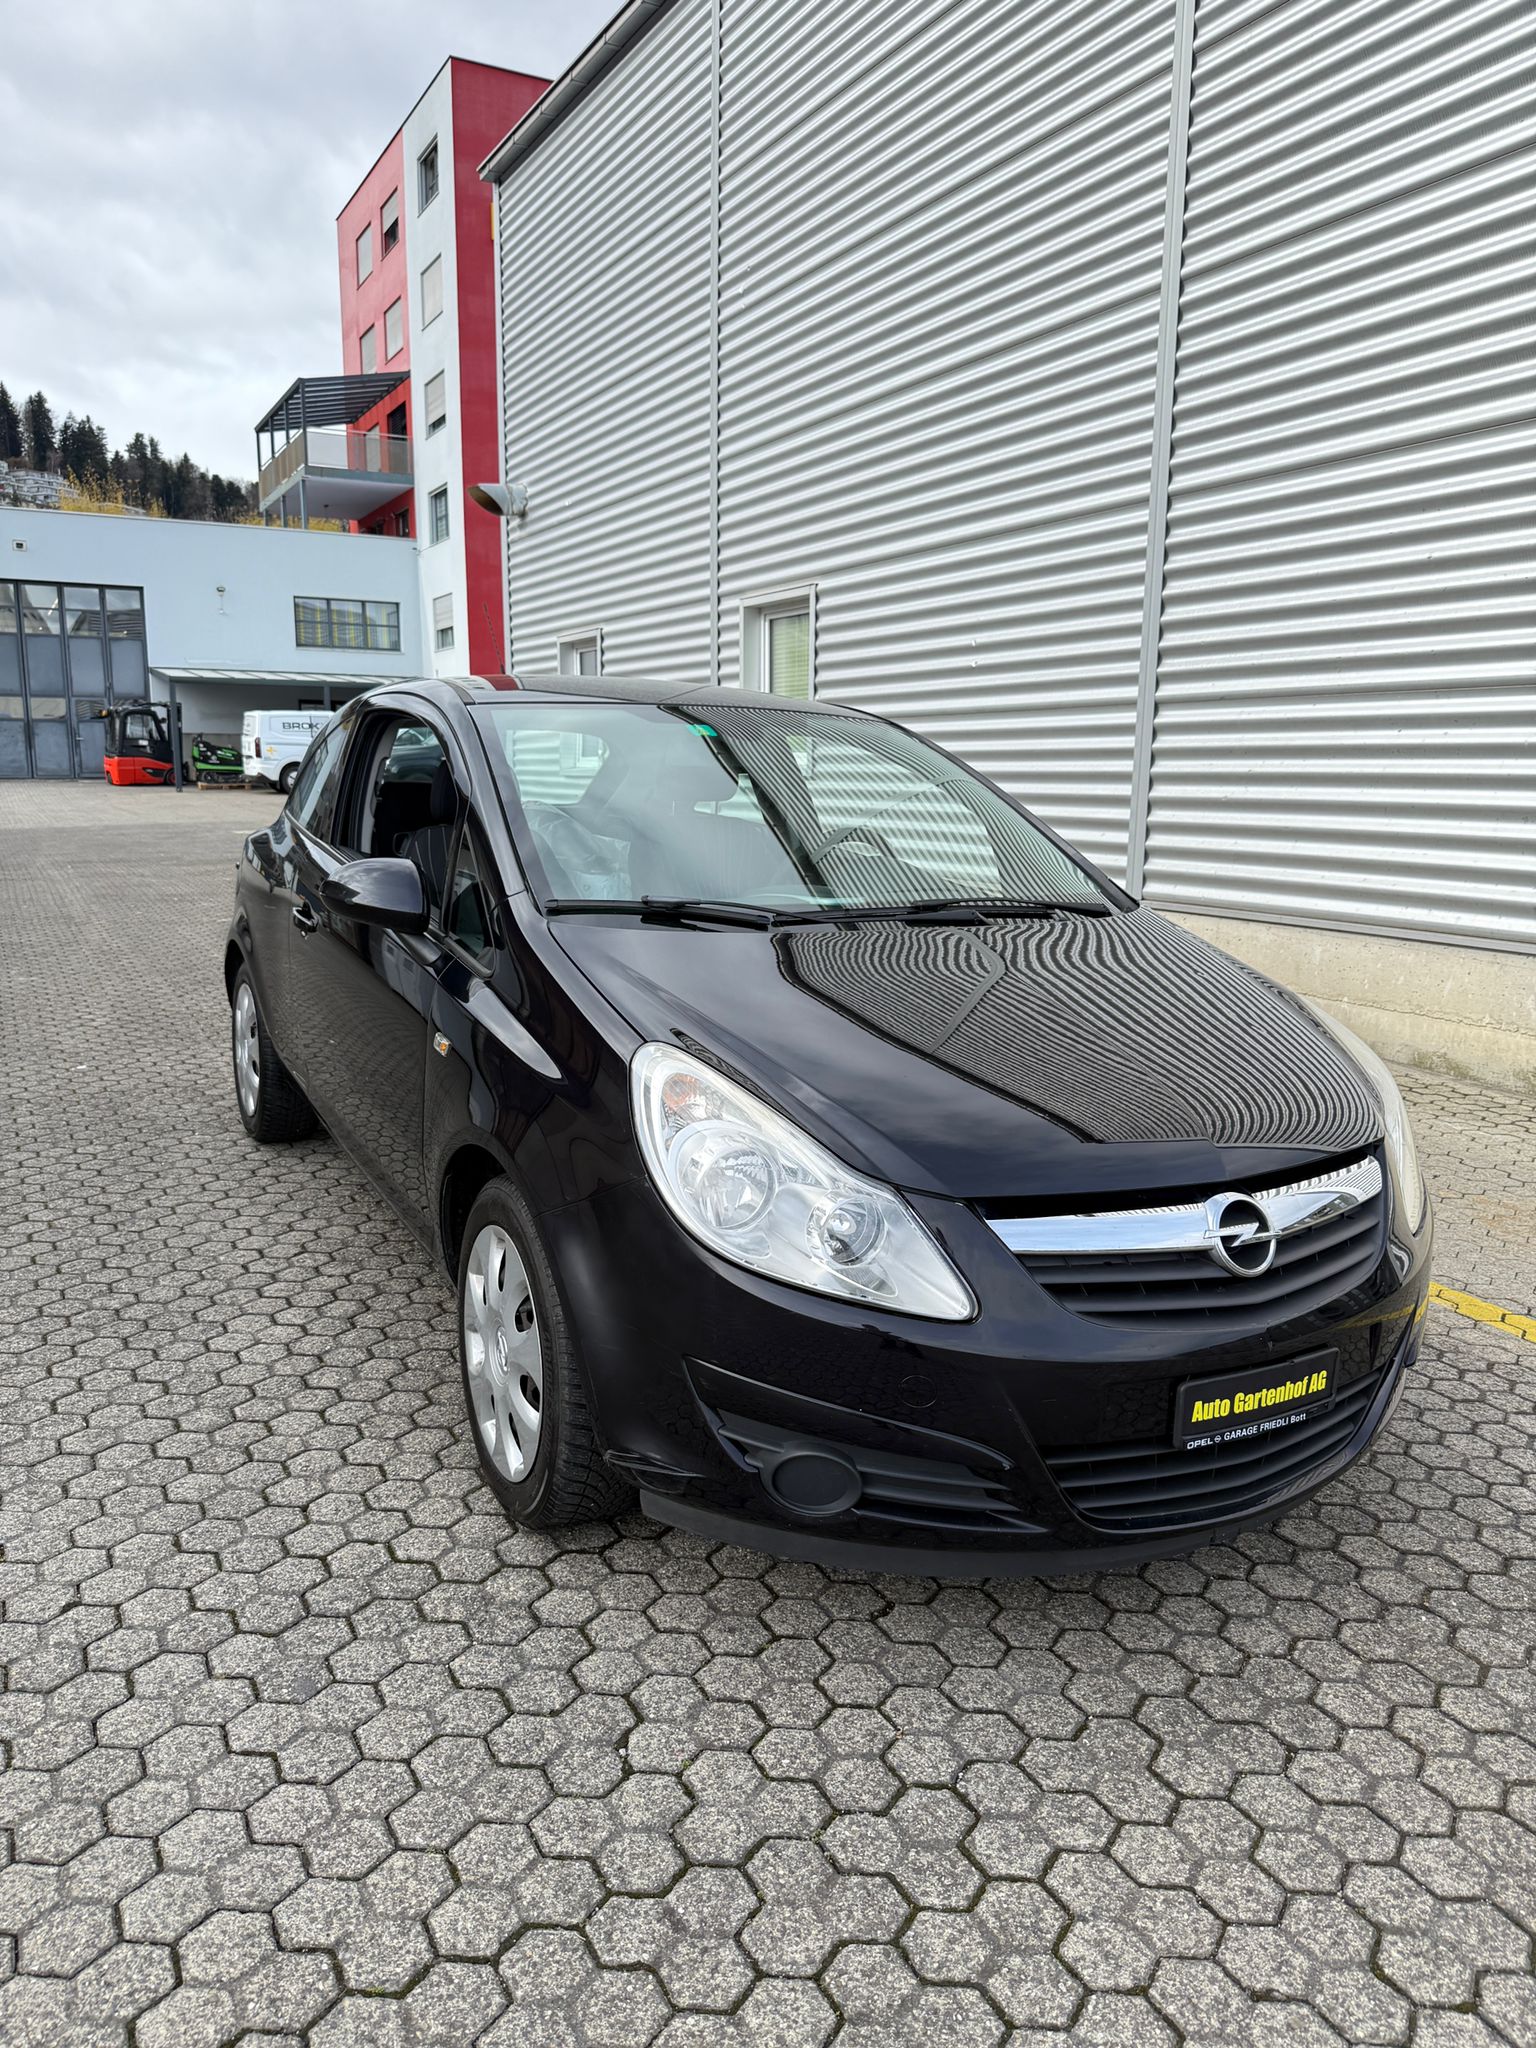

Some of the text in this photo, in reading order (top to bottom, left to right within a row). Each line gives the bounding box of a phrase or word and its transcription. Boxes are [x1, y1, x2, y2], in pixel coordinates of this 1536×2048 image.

[282, 722, 323, 730] BROK
[1191, 1370, 1327, 1422] Auto Gartenhof AG
[1187, 1412, 1306, 1450] OPEL GARAGE FRIEDLI Bott
